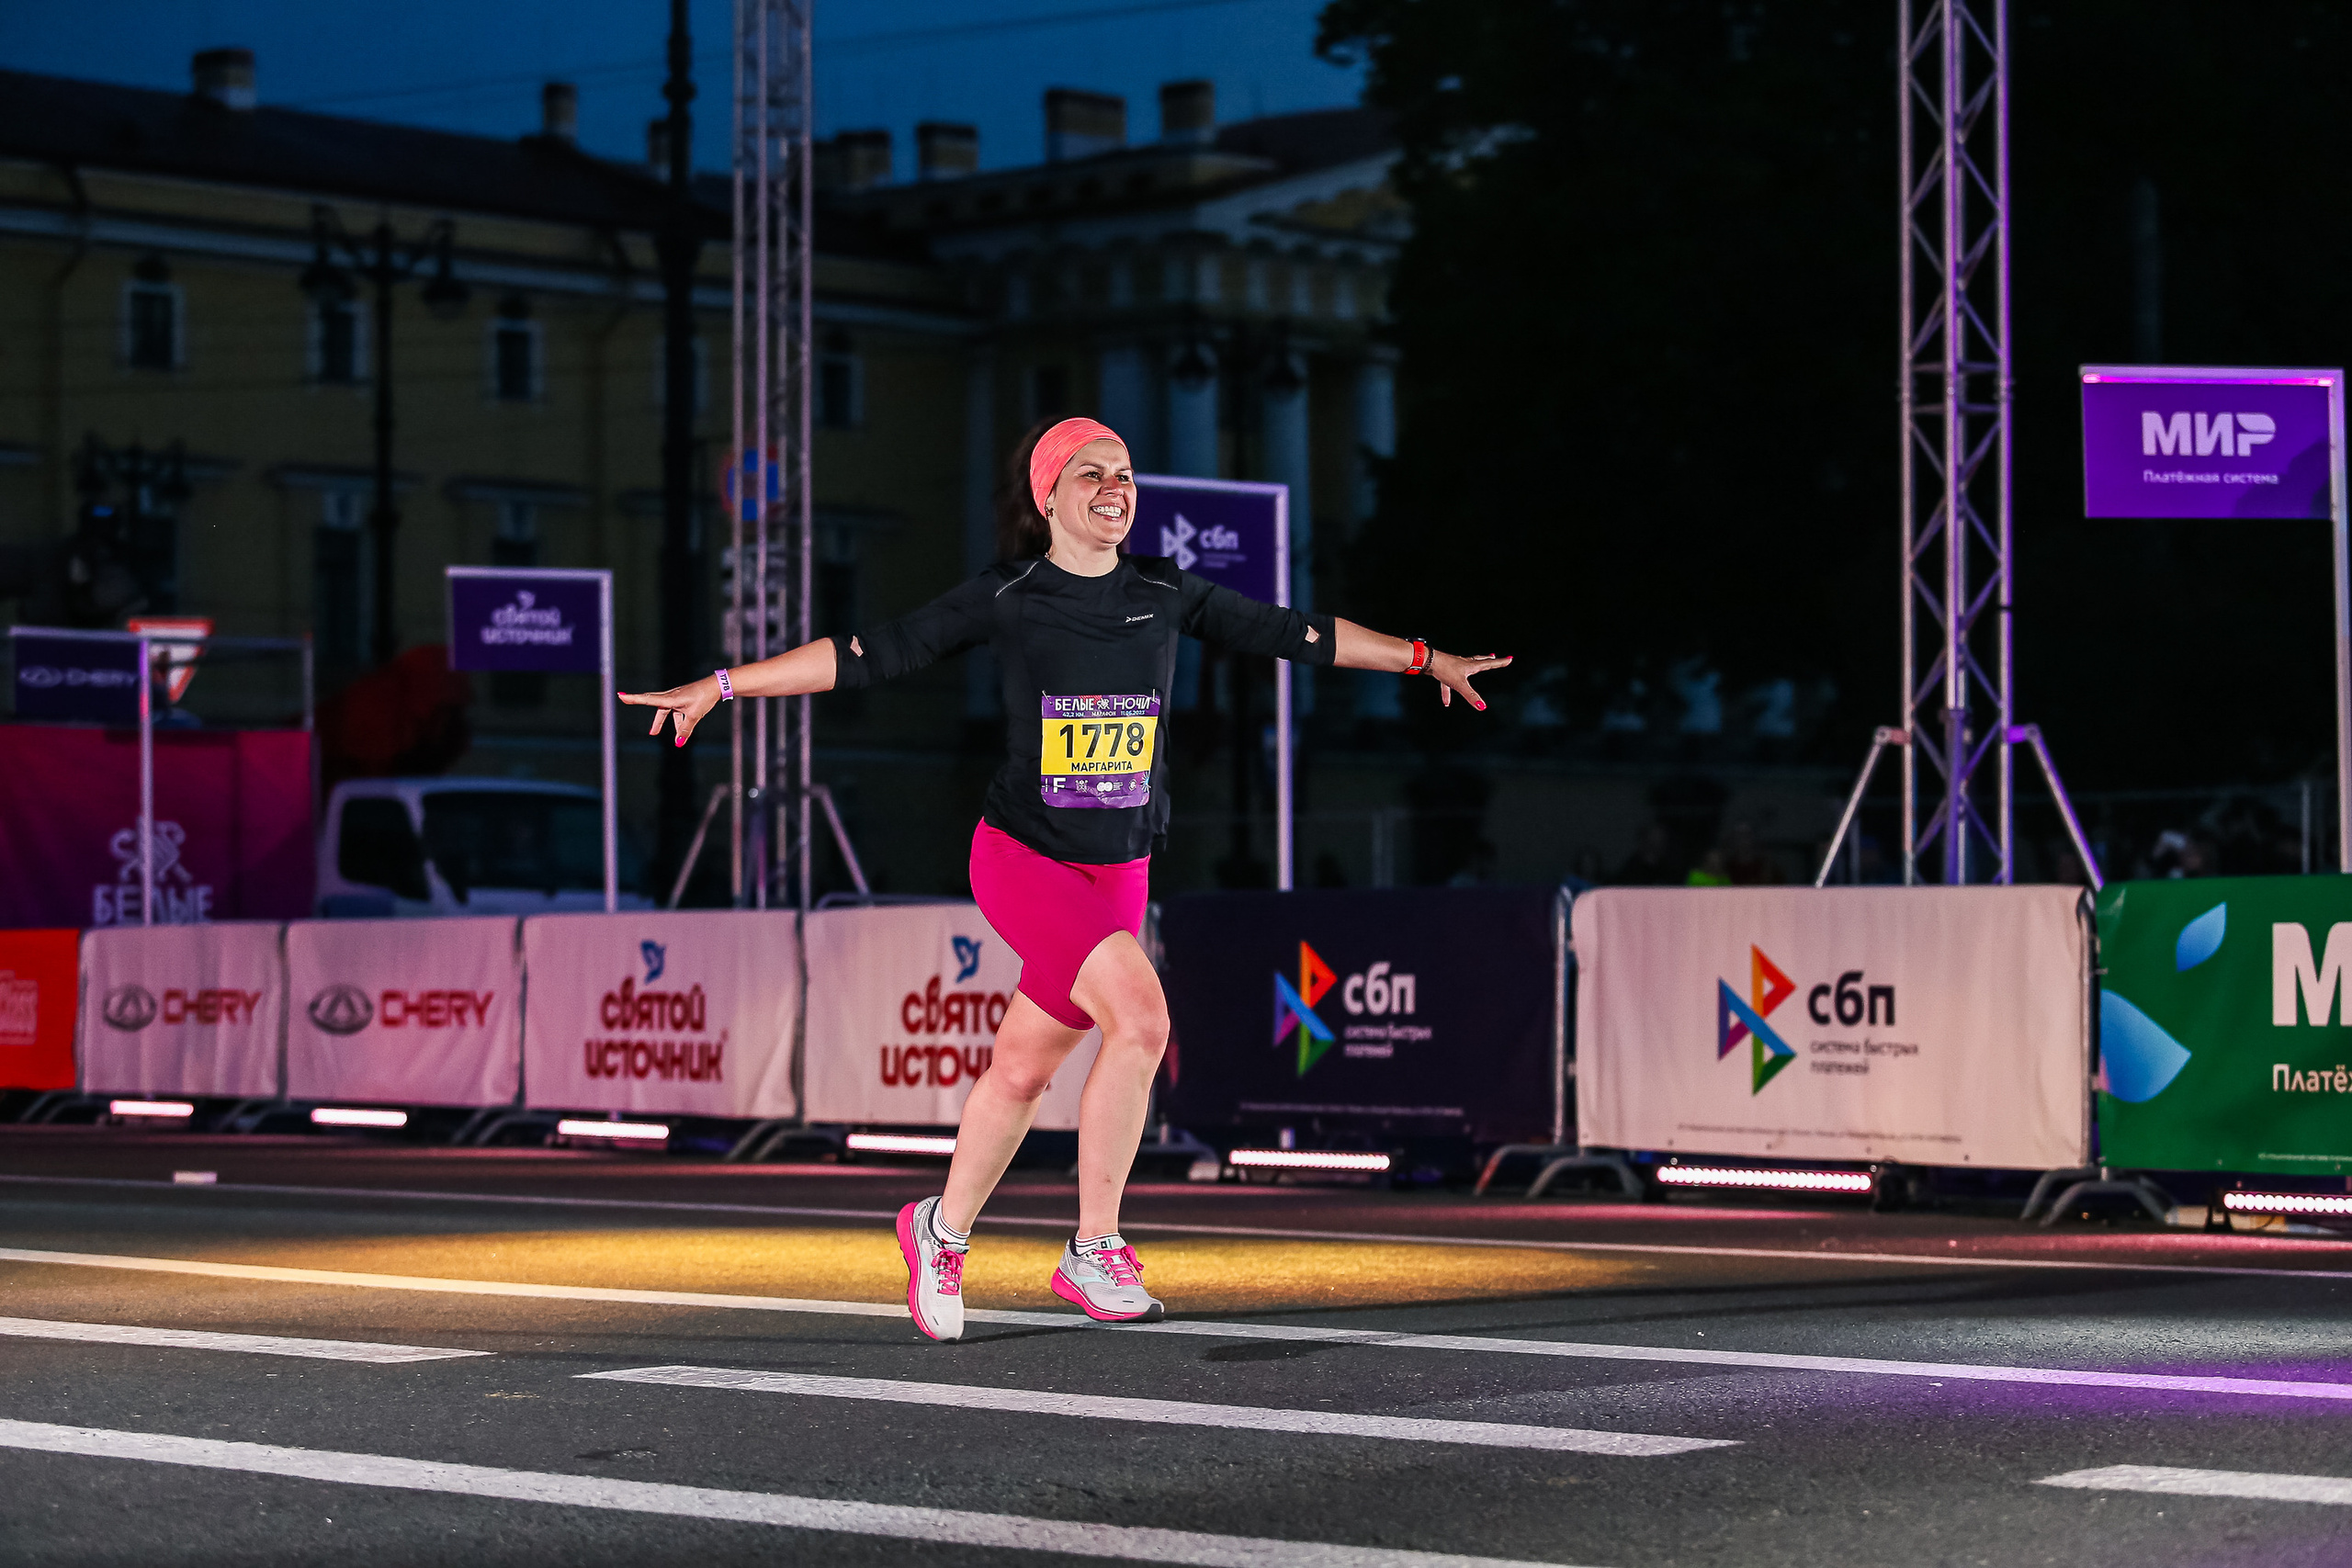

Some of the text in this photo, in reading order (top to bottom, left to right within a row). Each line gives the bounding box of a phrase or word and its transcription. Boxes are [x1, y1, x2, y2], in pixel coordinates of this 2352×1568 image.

[2142, 411, 2277, 457] МИР
[1054, 696, 1151, 712] БЕЛЫЕ НОЧИ
[1059, 722, 1145, 759] 1778
[1071, 761, 1133, 773] МАРГАРИТА
[164, 988, 262, 1025] CHERY
[900, 972, 1013, 1035] свято
[1342, 961, 1416, 1015] сбп
[1807, 970, 1896, 1027] сбп
[380, 989, 494, 1029] CHERY
[2272, 1063, 2352, 1093] Платё
